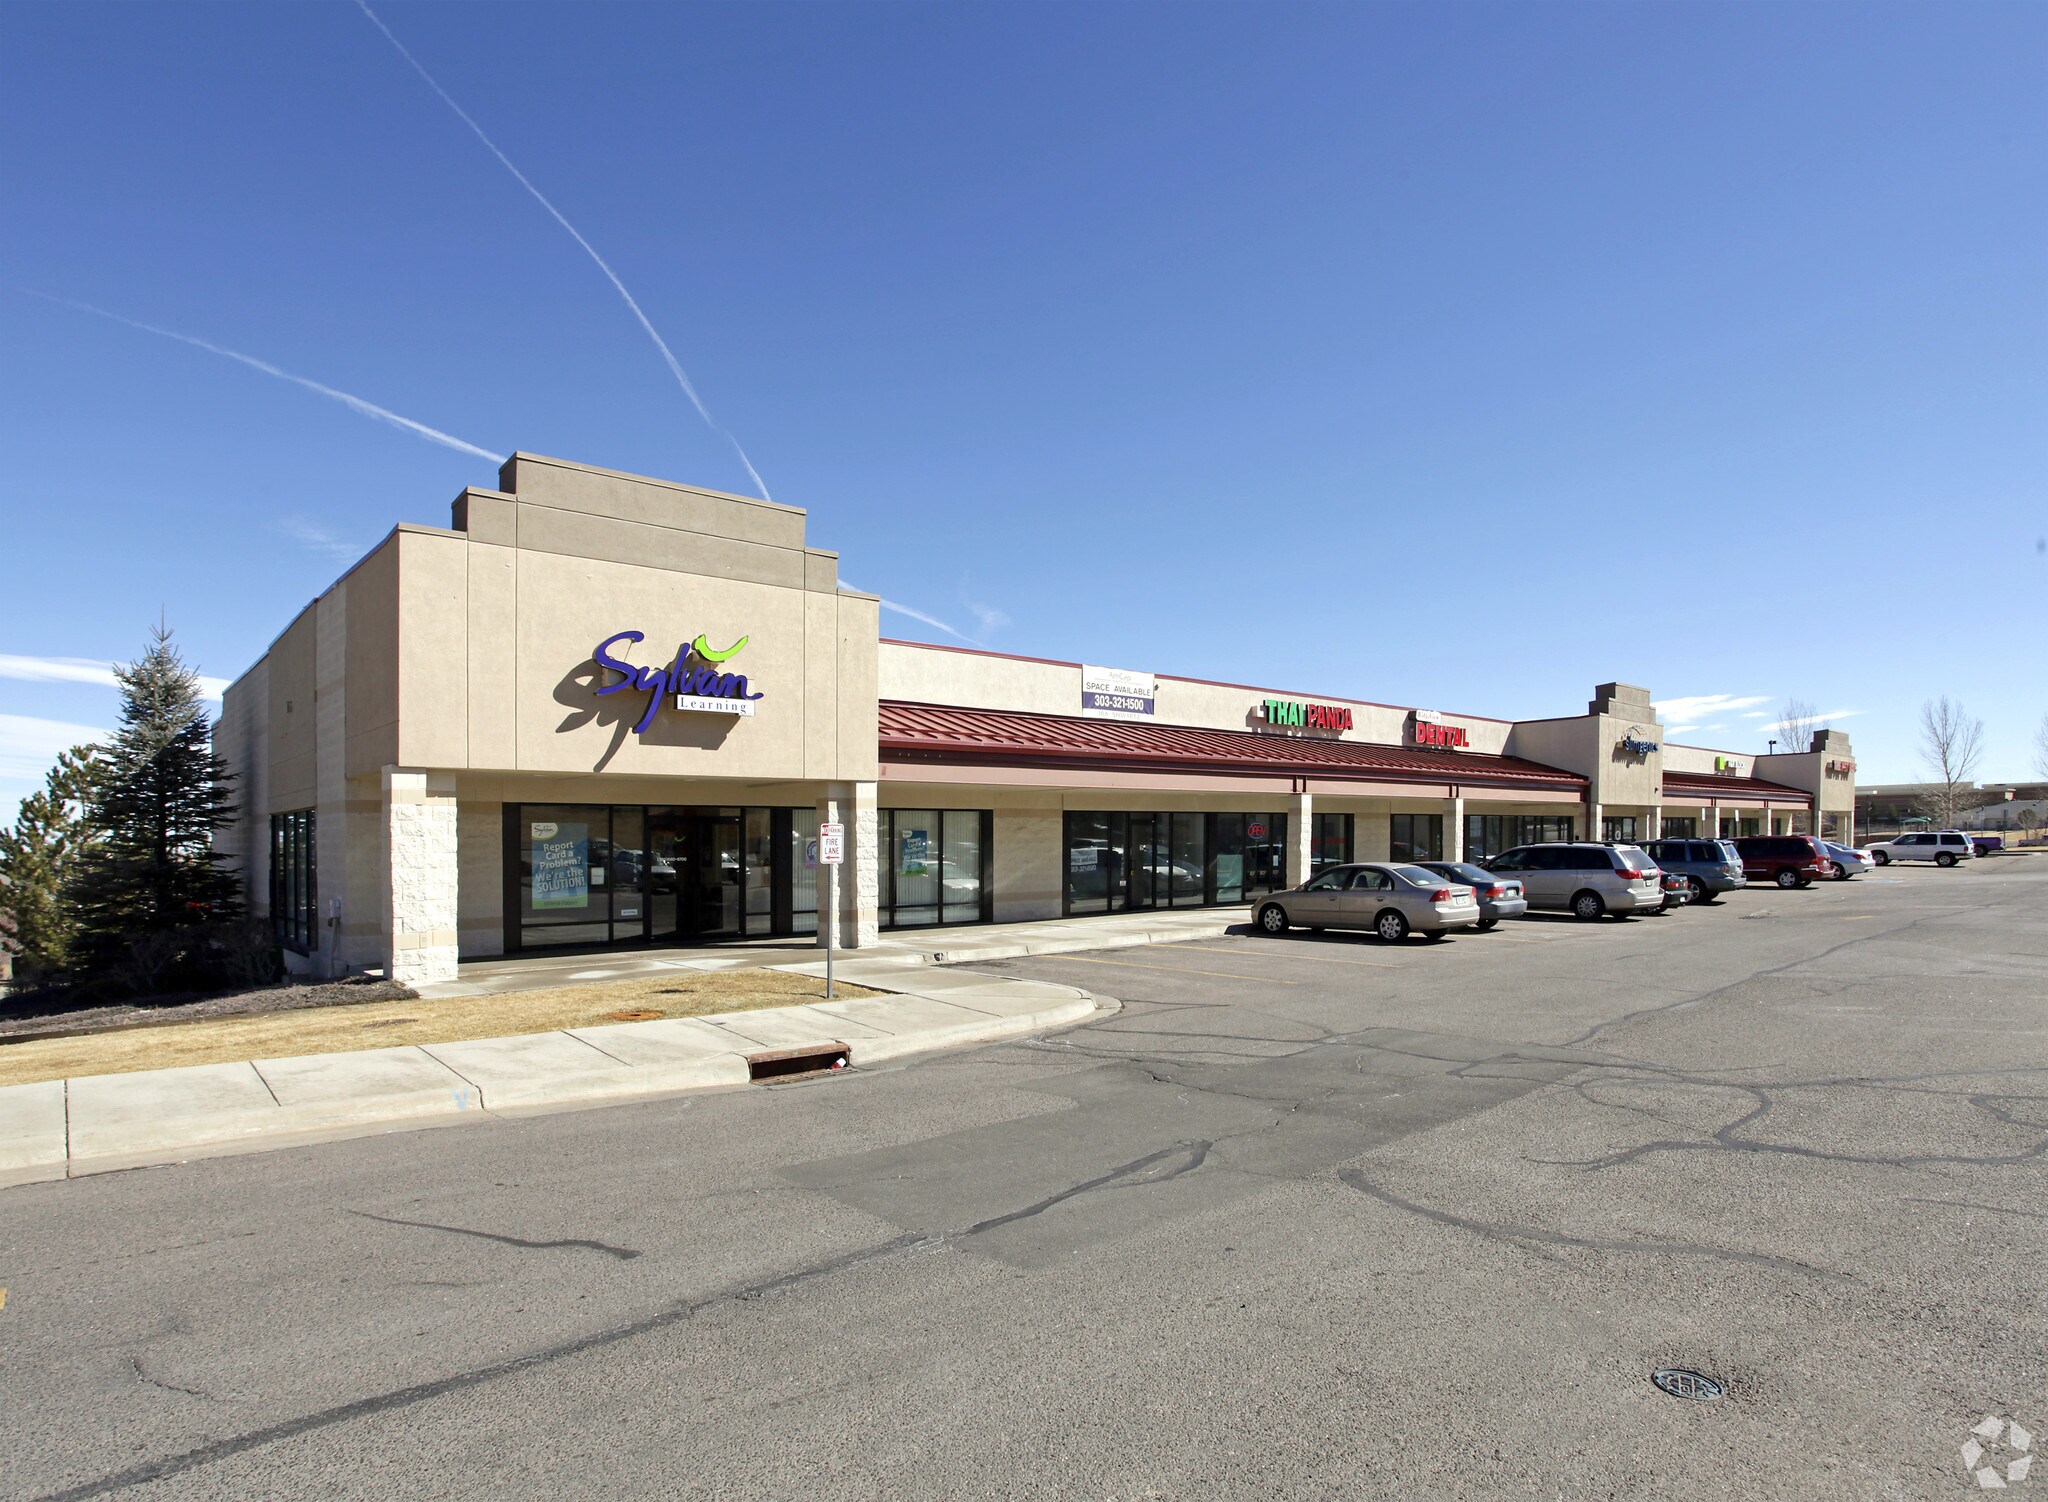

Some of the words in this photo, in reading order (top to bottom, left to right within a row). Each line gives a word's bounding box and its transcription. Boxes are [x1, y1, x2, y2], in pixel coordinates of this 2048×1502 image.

[592, 630, 765, 735] Sylvan
[1086, 681, 1110, 692] SPACE
[1114, 685, 1151, 696] AVAILABLE
[680, 696, 747, 715] Learning
[1094, 694, 1144, 711] 303-321-1500
[1264, 699, 1305, 727] THAI
[1307, 703, 1353, 730] PANDA
[1415, 721, 1469, 747] DENTAL
[543, 841, 574, 852] Report
[825, 838, 839, 846] FIRE
[545, 850, 566, 860] Card
[824, 847, 840, 855] LANE
[539, 856, 581, 870] Problem?
[535, 871, 565, 882] We're
[566, 868, 584, 878] the
[536, 877, 586, 893] SOLUTION!
